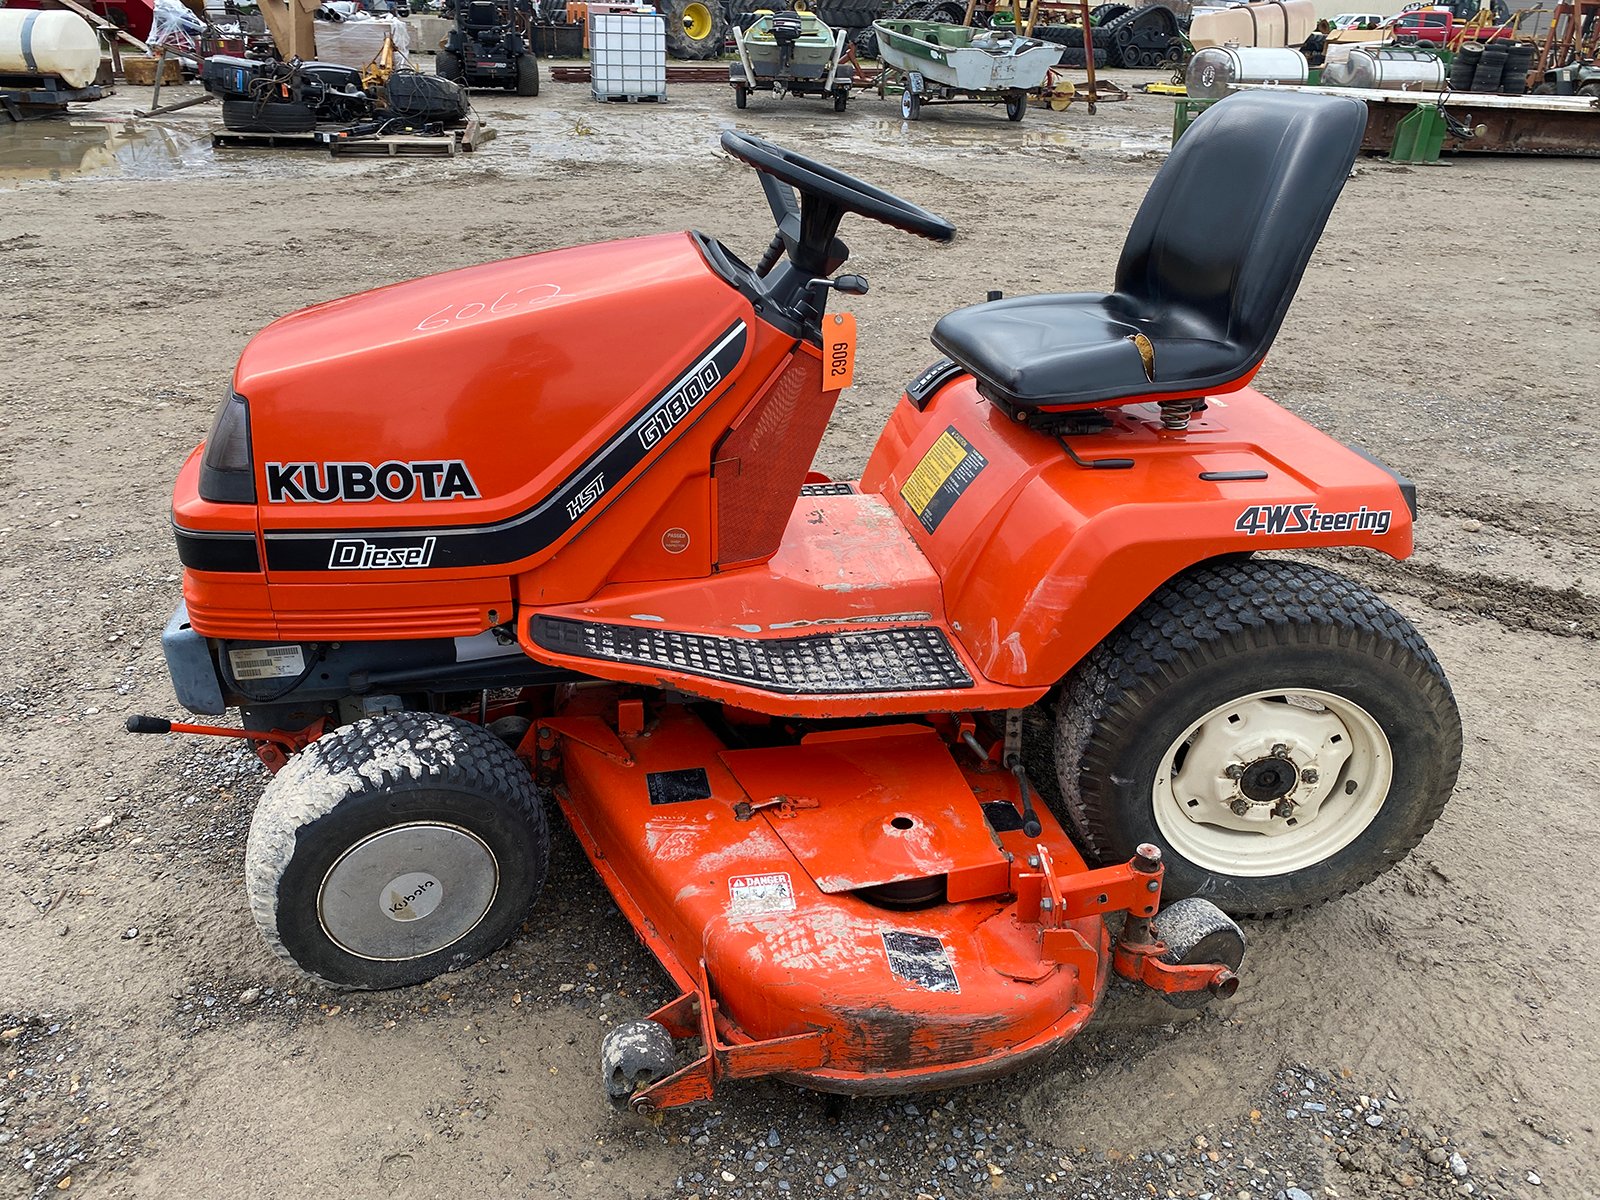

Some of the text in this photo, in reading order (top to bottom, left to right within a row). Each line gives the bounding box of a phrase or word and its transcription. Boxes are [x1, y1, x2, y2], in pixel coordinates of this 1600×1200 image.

[413, 283, 577, 331] 6062
[831, 342, 849, 376] 6062
[637, 359, 721, 450] G1800
[265, 460, 483, 503] KUBOTA
[566, 471, 605, 521] HST
[1234, 502, 1393, 536] 4WSteering
[328, 537, 436, 569] Diesel
[388, 880, 435, 913] Kubota
[746, 874, 787, 888] DANGER
